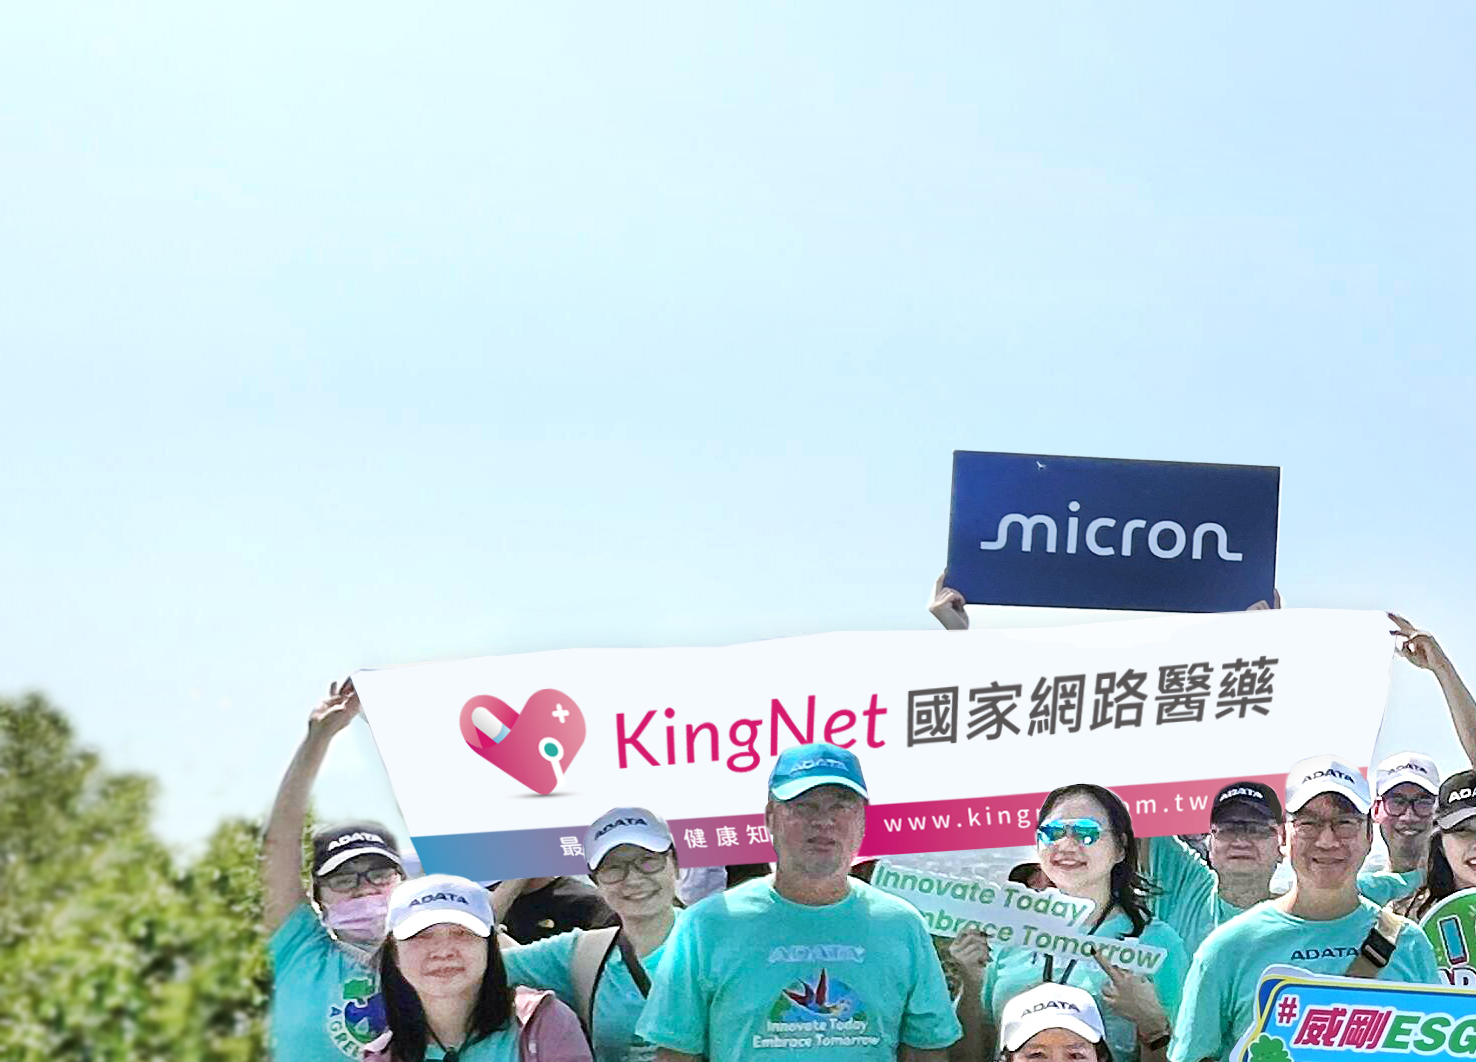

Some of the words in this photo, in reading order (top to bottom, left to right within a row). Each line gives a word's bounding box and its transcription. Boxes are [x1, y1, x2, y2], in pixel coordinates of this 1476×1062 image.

[980, 501, 1243, 561] micron
[615, 693, 888, 773] KingNet
[906, 655, 1279, 748] 國家網路醫藥
[1302, 768, 1356, 784] ADATA
[1219, 787, 1264, 802] ADATA
[328, 832, 386, 851] ADATA
[408, 892, 470, 907] ADATA
[875, 865, 996, 904] Innovate
[1002, 888, 1088, 927] Today
[921, 908, 1014, 942] brace
[1023, 924, 1161, 969] Tomorrow
[1440, 916, 1467, 965] I
[1290, 947, 1360, 960] ADATA
[1021, 1000, 1081, 1018] ADATA
